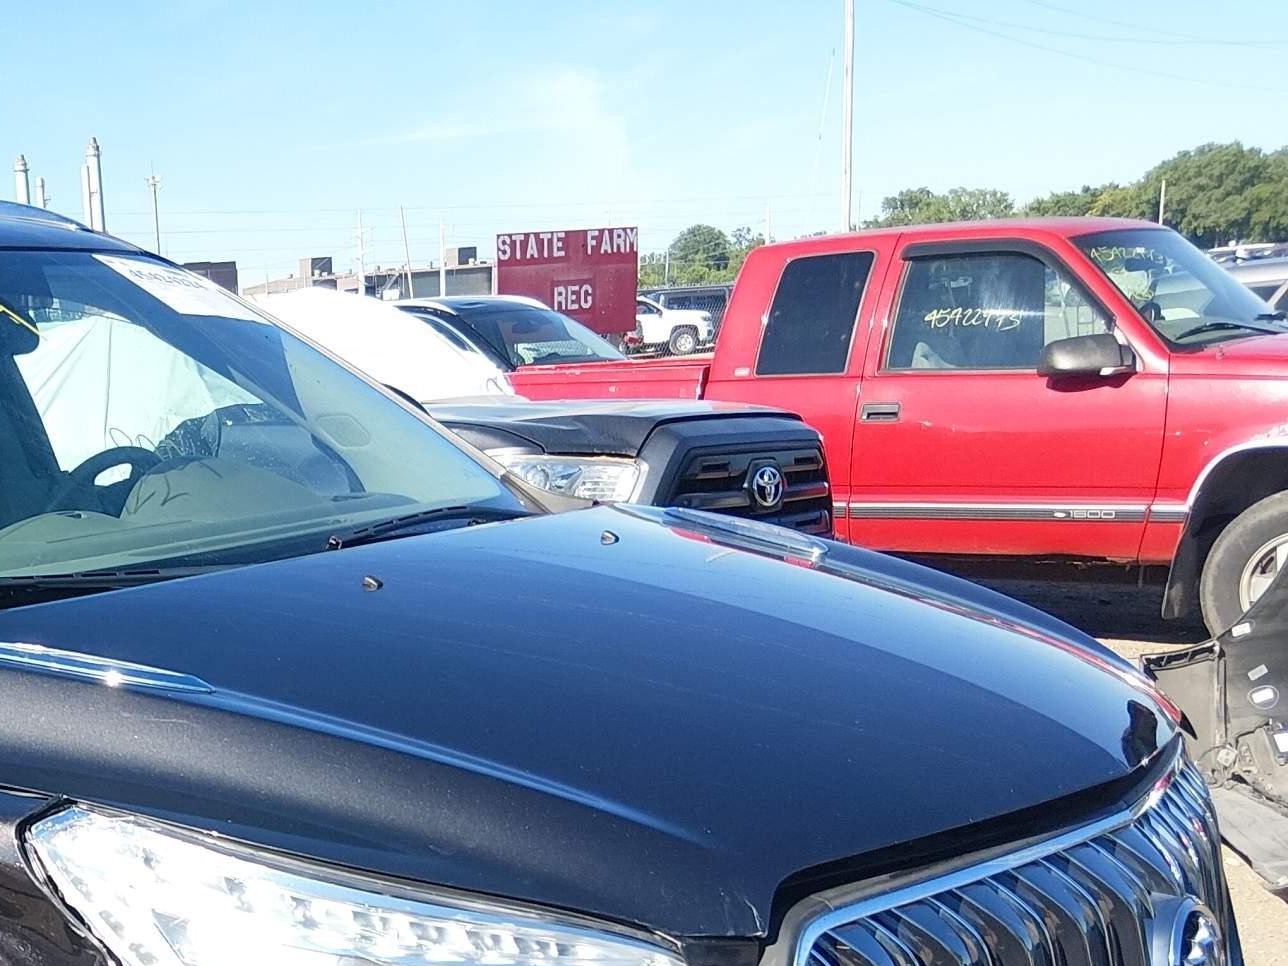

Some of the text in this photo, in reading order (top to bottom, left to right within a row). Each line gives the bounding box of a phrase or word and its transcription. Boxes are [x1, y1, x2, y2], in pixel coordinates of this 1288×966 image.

[497, 228, 638, 261] STATE FARM
[553, 284, 593, 311] REG
